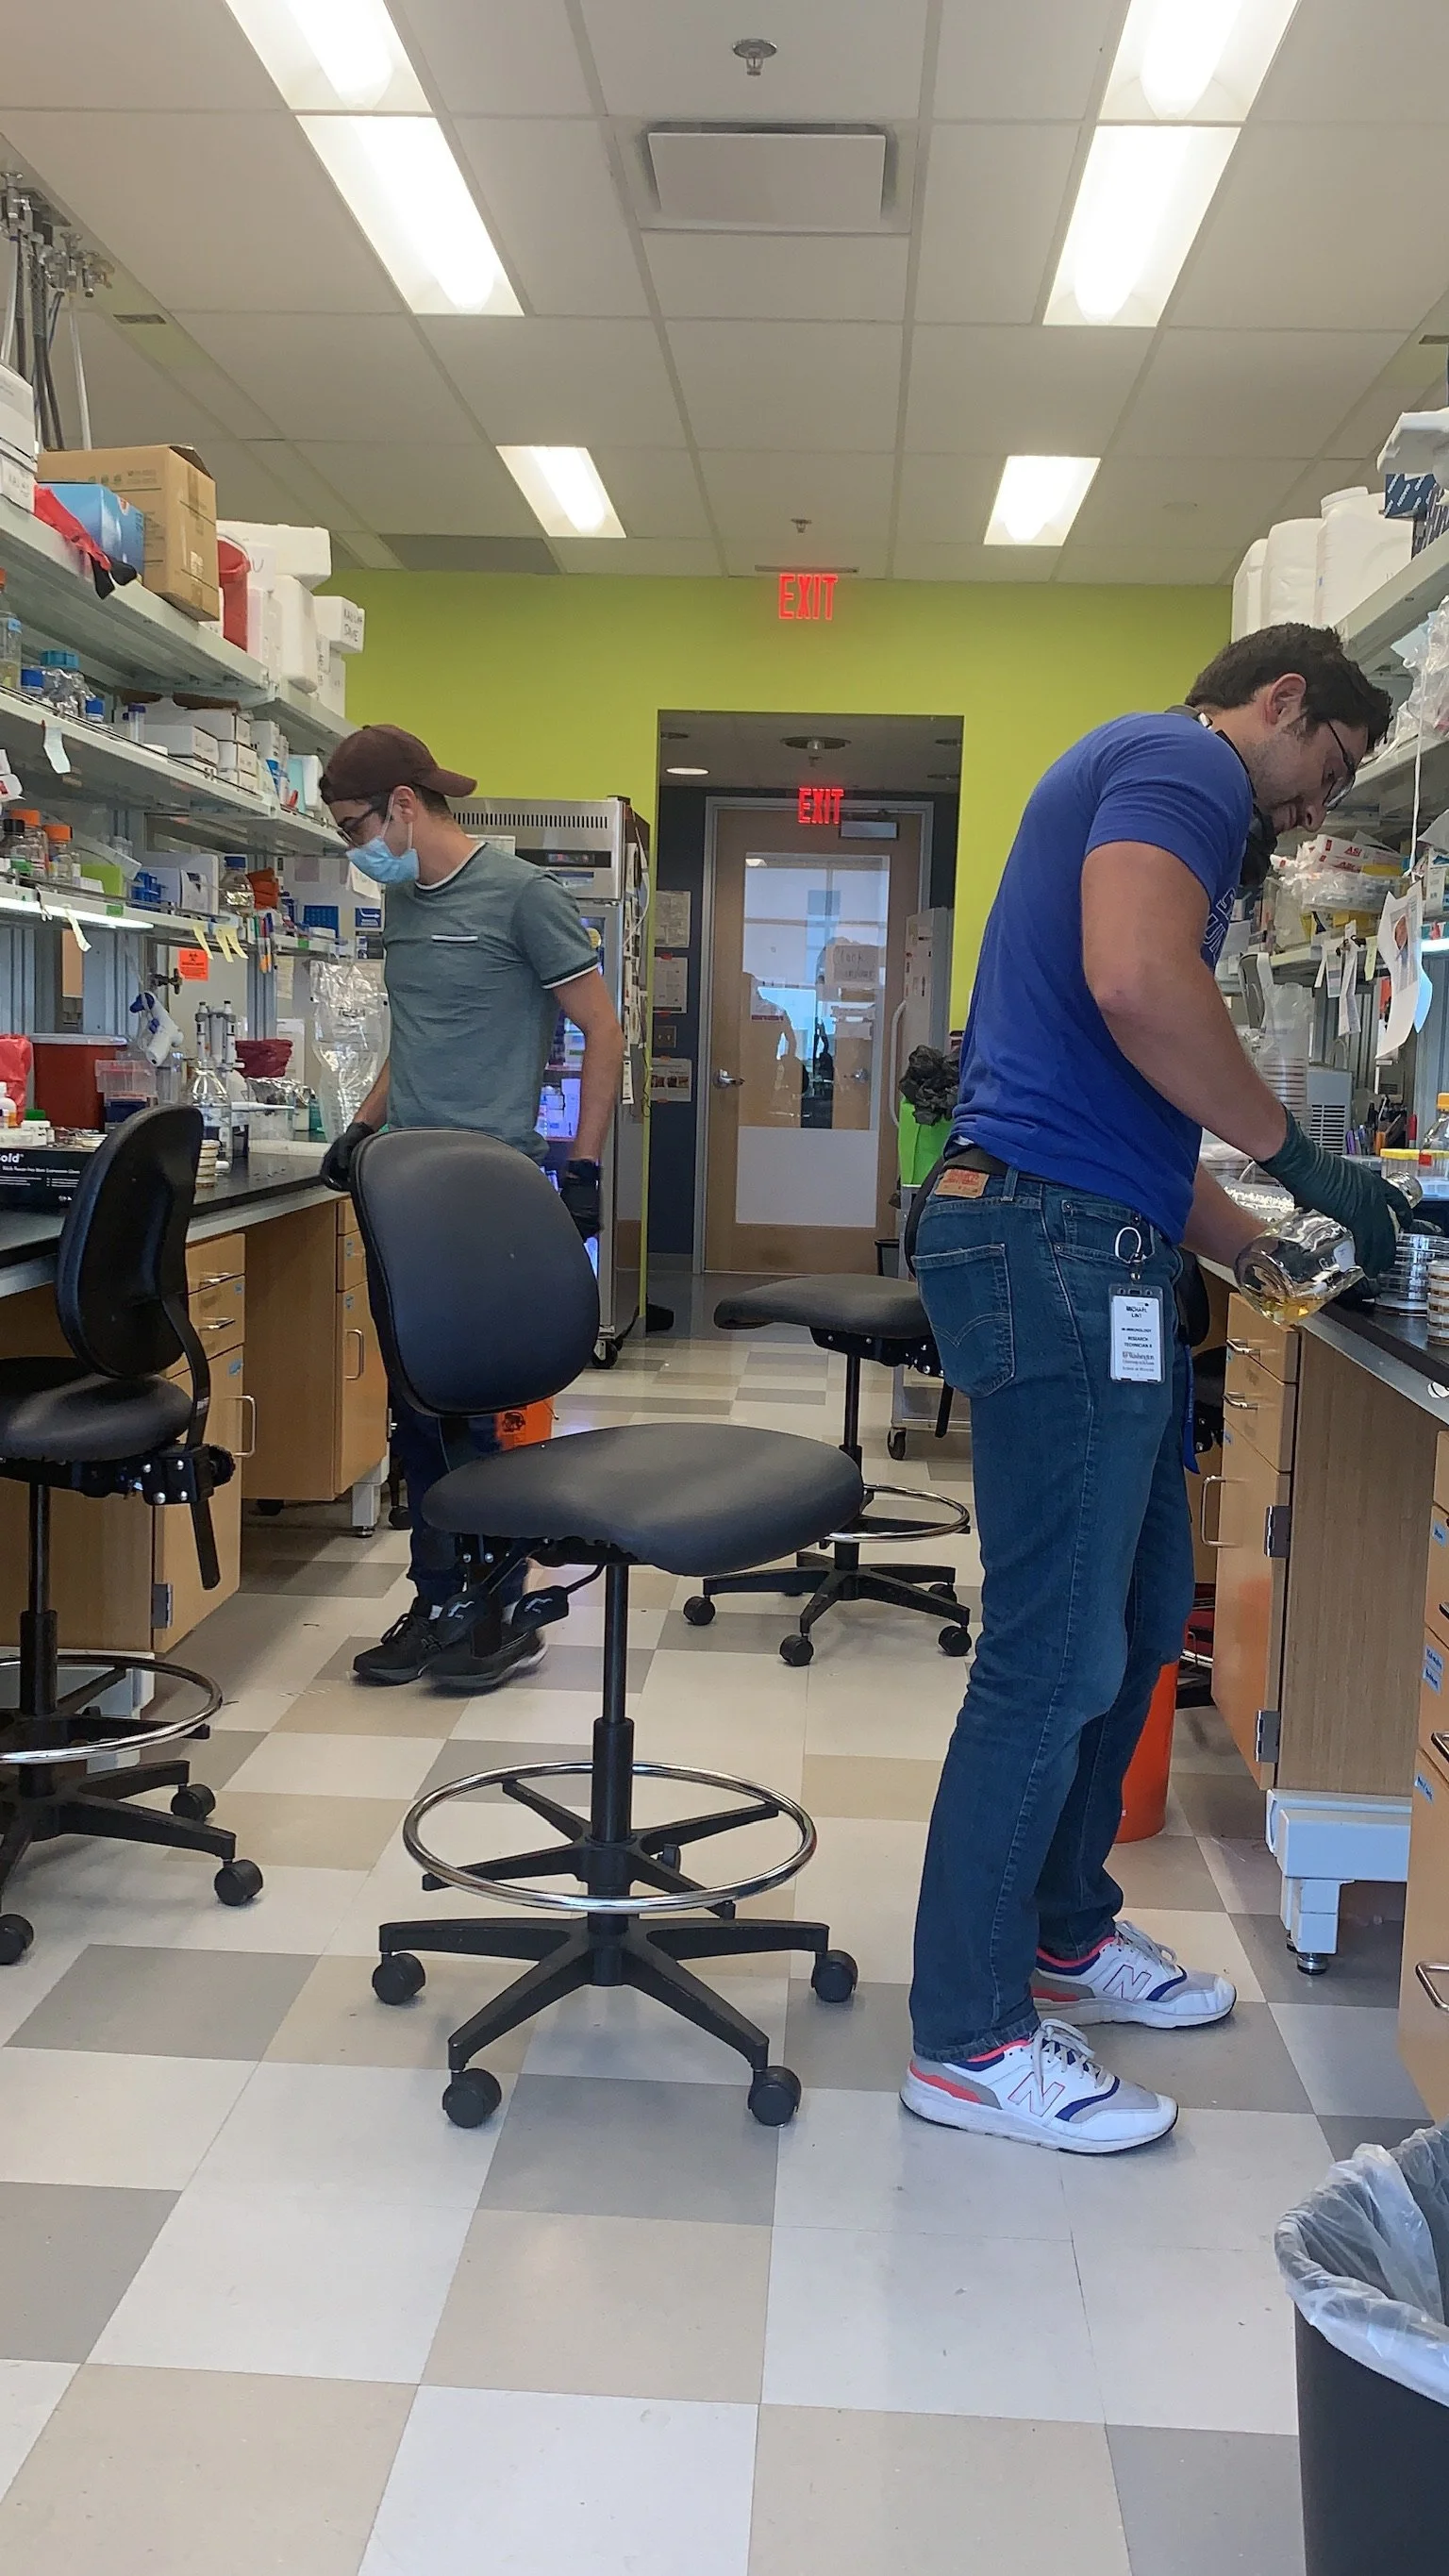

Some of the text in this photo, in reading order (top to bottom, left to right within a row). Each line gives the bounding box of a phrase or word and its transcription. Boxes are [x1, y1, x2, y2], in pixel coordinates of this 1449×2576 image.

[1397, 483, 1410, 507] QIAGEN
[778, 573, 839, 621] EXIT
[798, 787, 844, 825] EXIT
[0, 1152, 20, 1163] old
[1102, 1964, 1152, 2002] N
[1008, 2071, 1066, 2118] N
